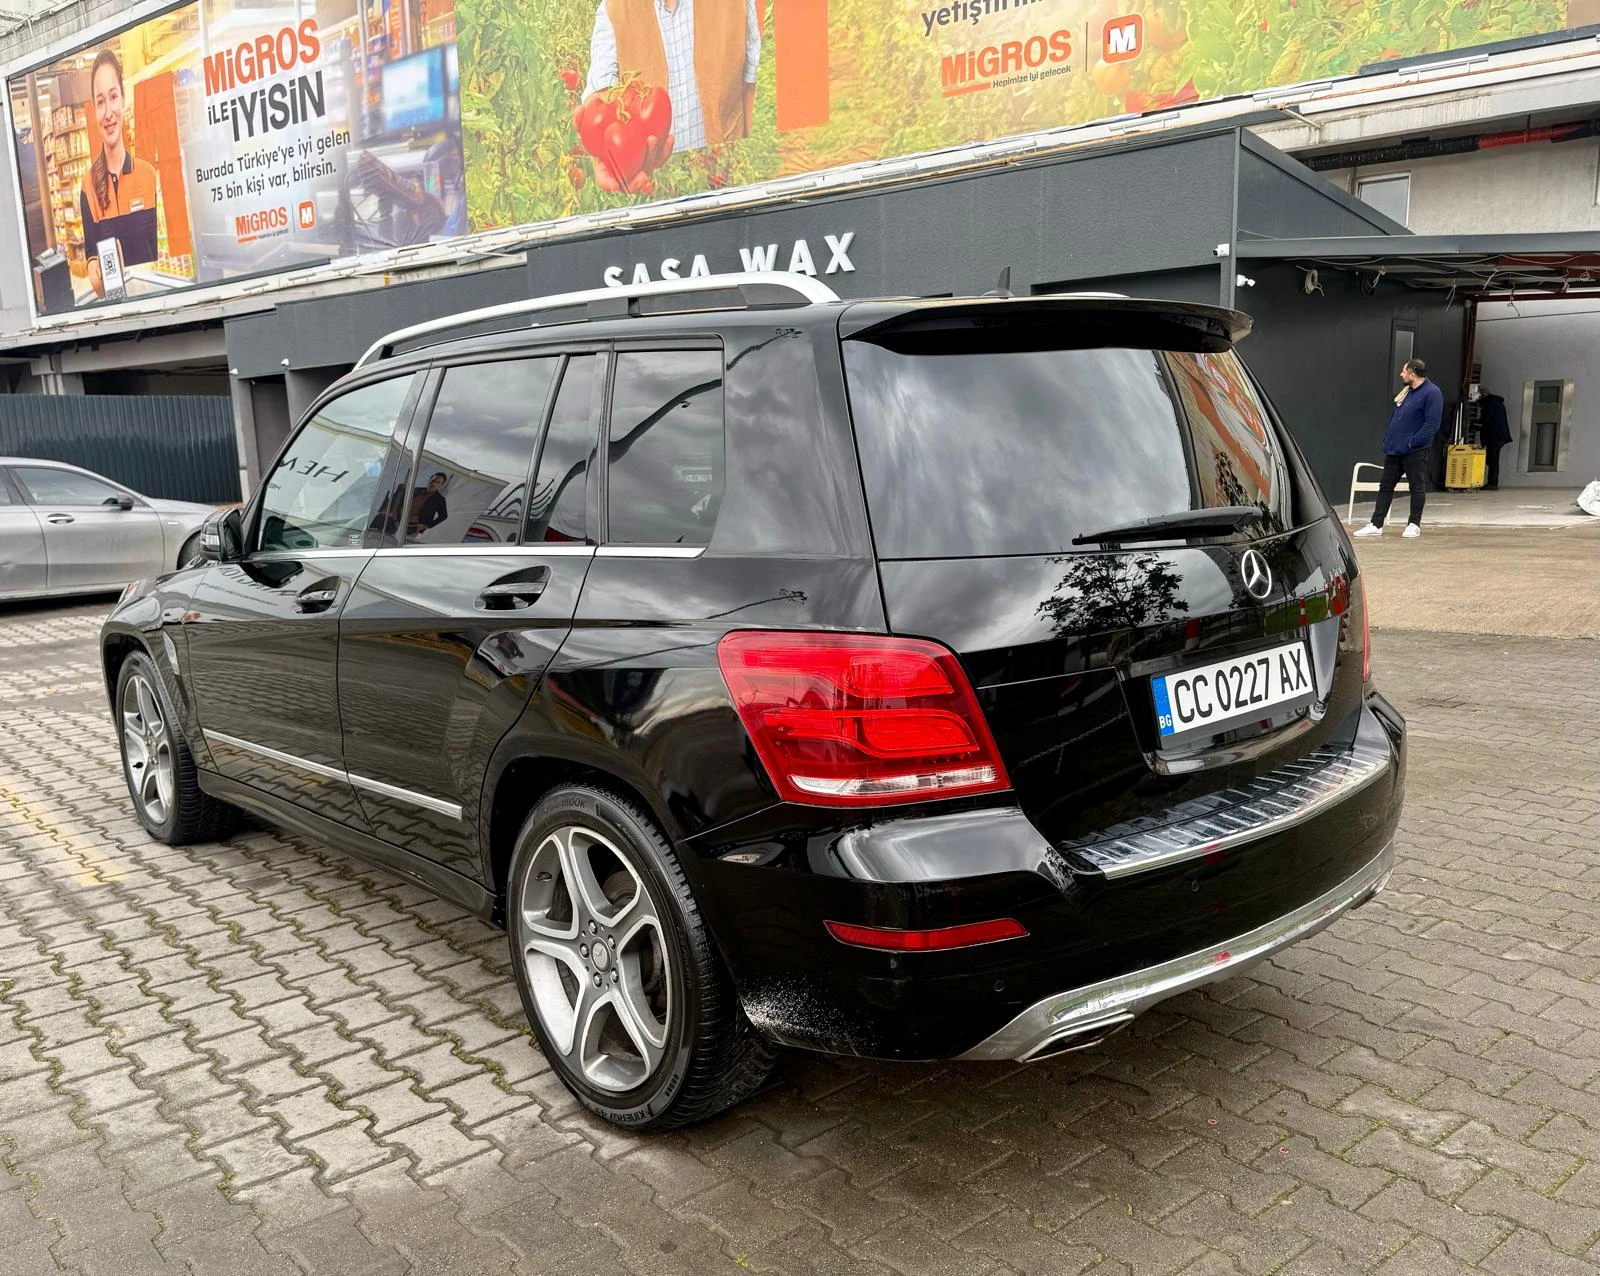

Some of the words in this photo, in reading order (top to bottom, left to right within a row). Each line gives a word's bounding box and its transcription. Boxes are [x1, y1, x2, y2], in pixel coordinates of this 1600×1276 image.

[921, 0, 1042, 37] yetişti
[992, 74, 1029, 89] Hepimize
[1029, 71, 1039, 83] iyi
[1039, 65, 1072, 81] gelecek
[196, 160, 235, 183] Burada
[237, 145, 295, 172] Türkiye'ye
[298, 136, 313, 160] iyi
[316, 130, 351, 155] gelen
[211, 186, 224, 203] 75
[226, 181, 243, 199] bin
[246, 174, 265, 196] kişi
[268, 173, 290, 188] var,
[292, 158, 337, 182] bilirsin.
[603, 254, 711, 288] SASA
[739, 232, 855, 276] WAX
[1173, 674, 1213, 724] CC
[1215, 657, 1270, 712] 0227
[1278, 648, 1308, 694] AX
[1159, 715, 1173, 729] BG
